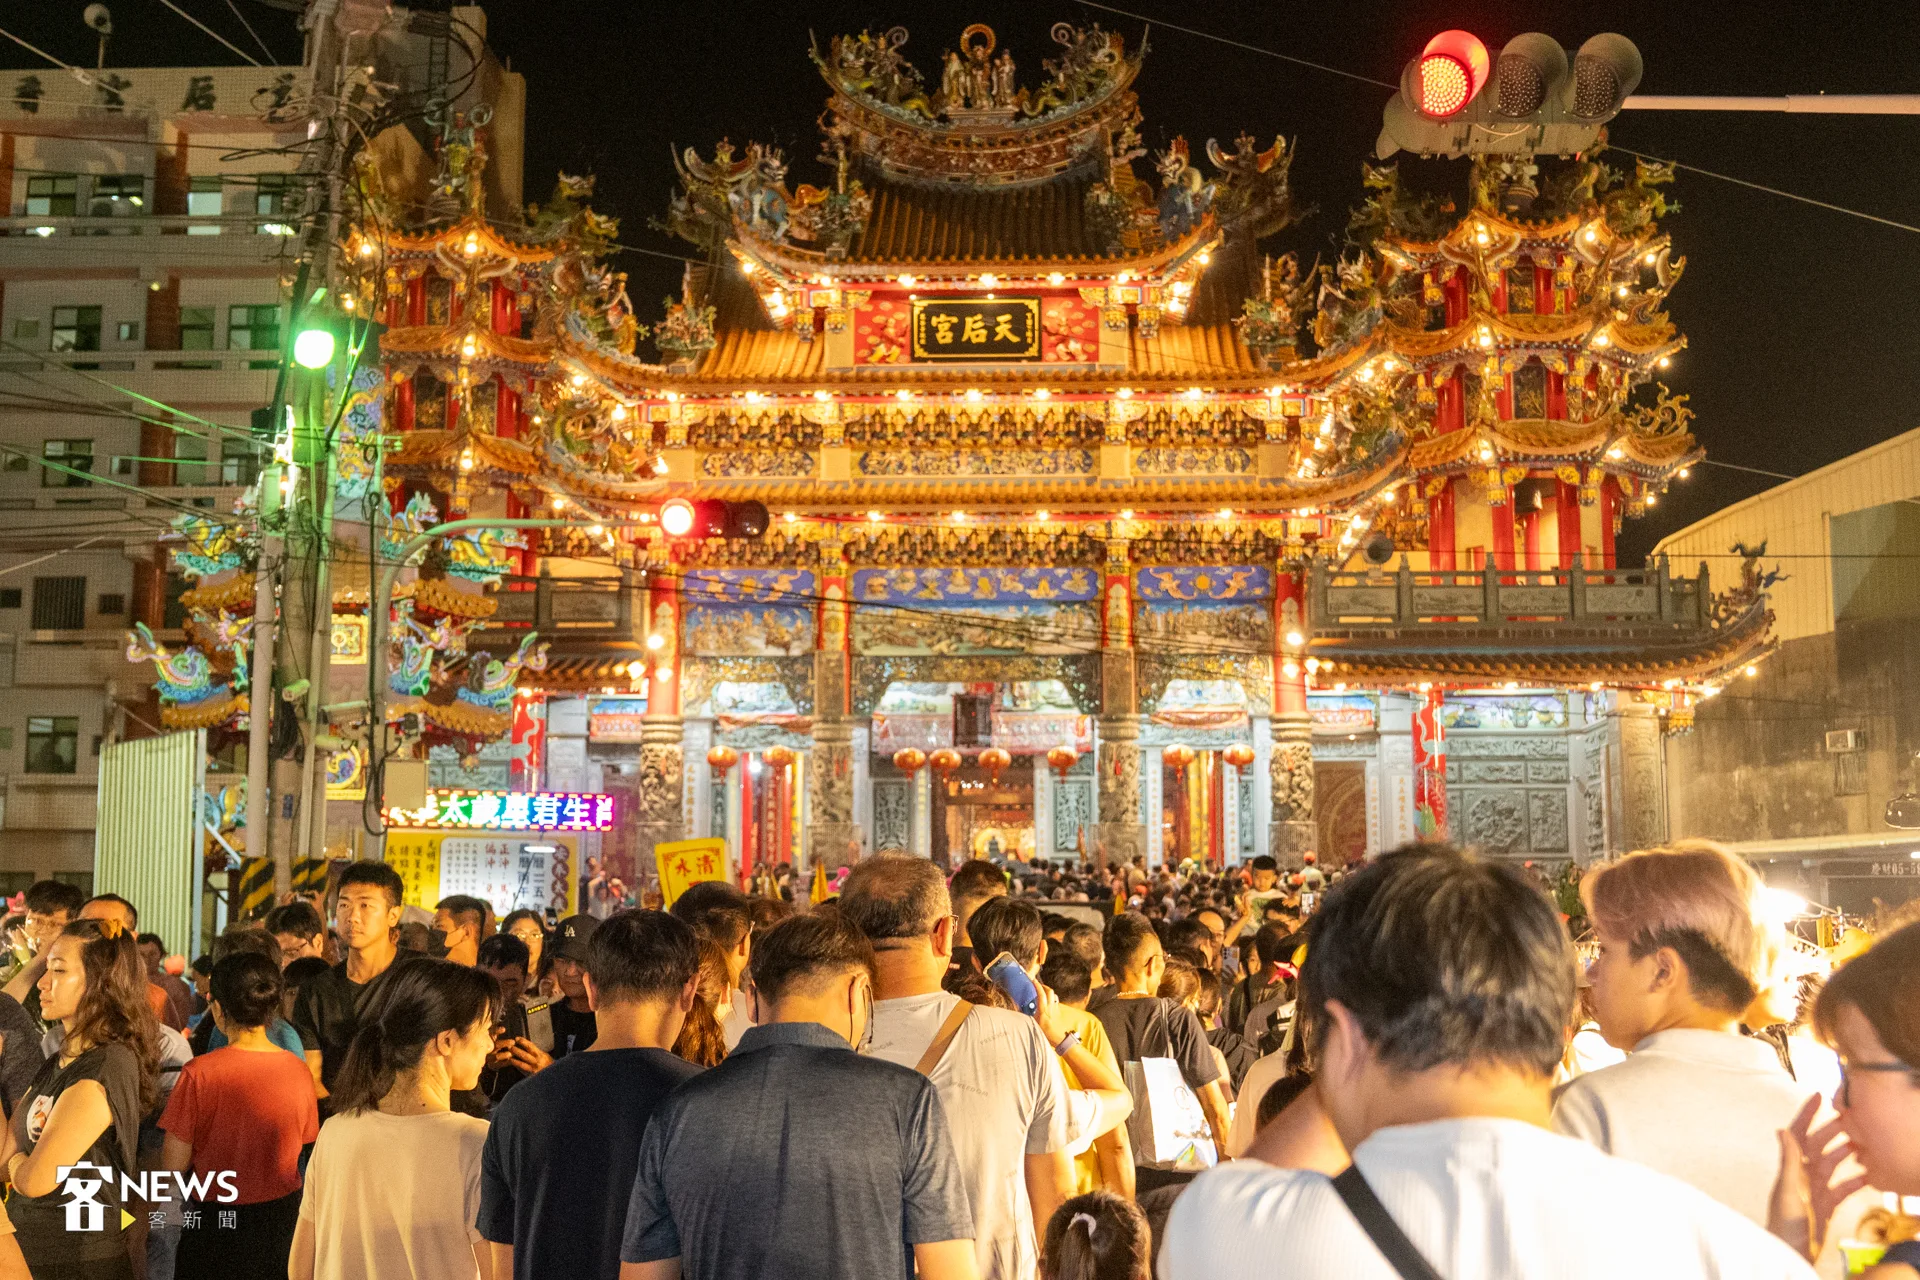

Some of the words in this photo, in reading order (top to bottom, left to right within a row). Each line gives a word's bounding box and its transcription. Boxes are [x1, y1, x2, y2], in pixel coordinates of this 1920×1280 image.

[930, 313, 1021, 345] 天后宮
[564, 925, 576, 937] LA
